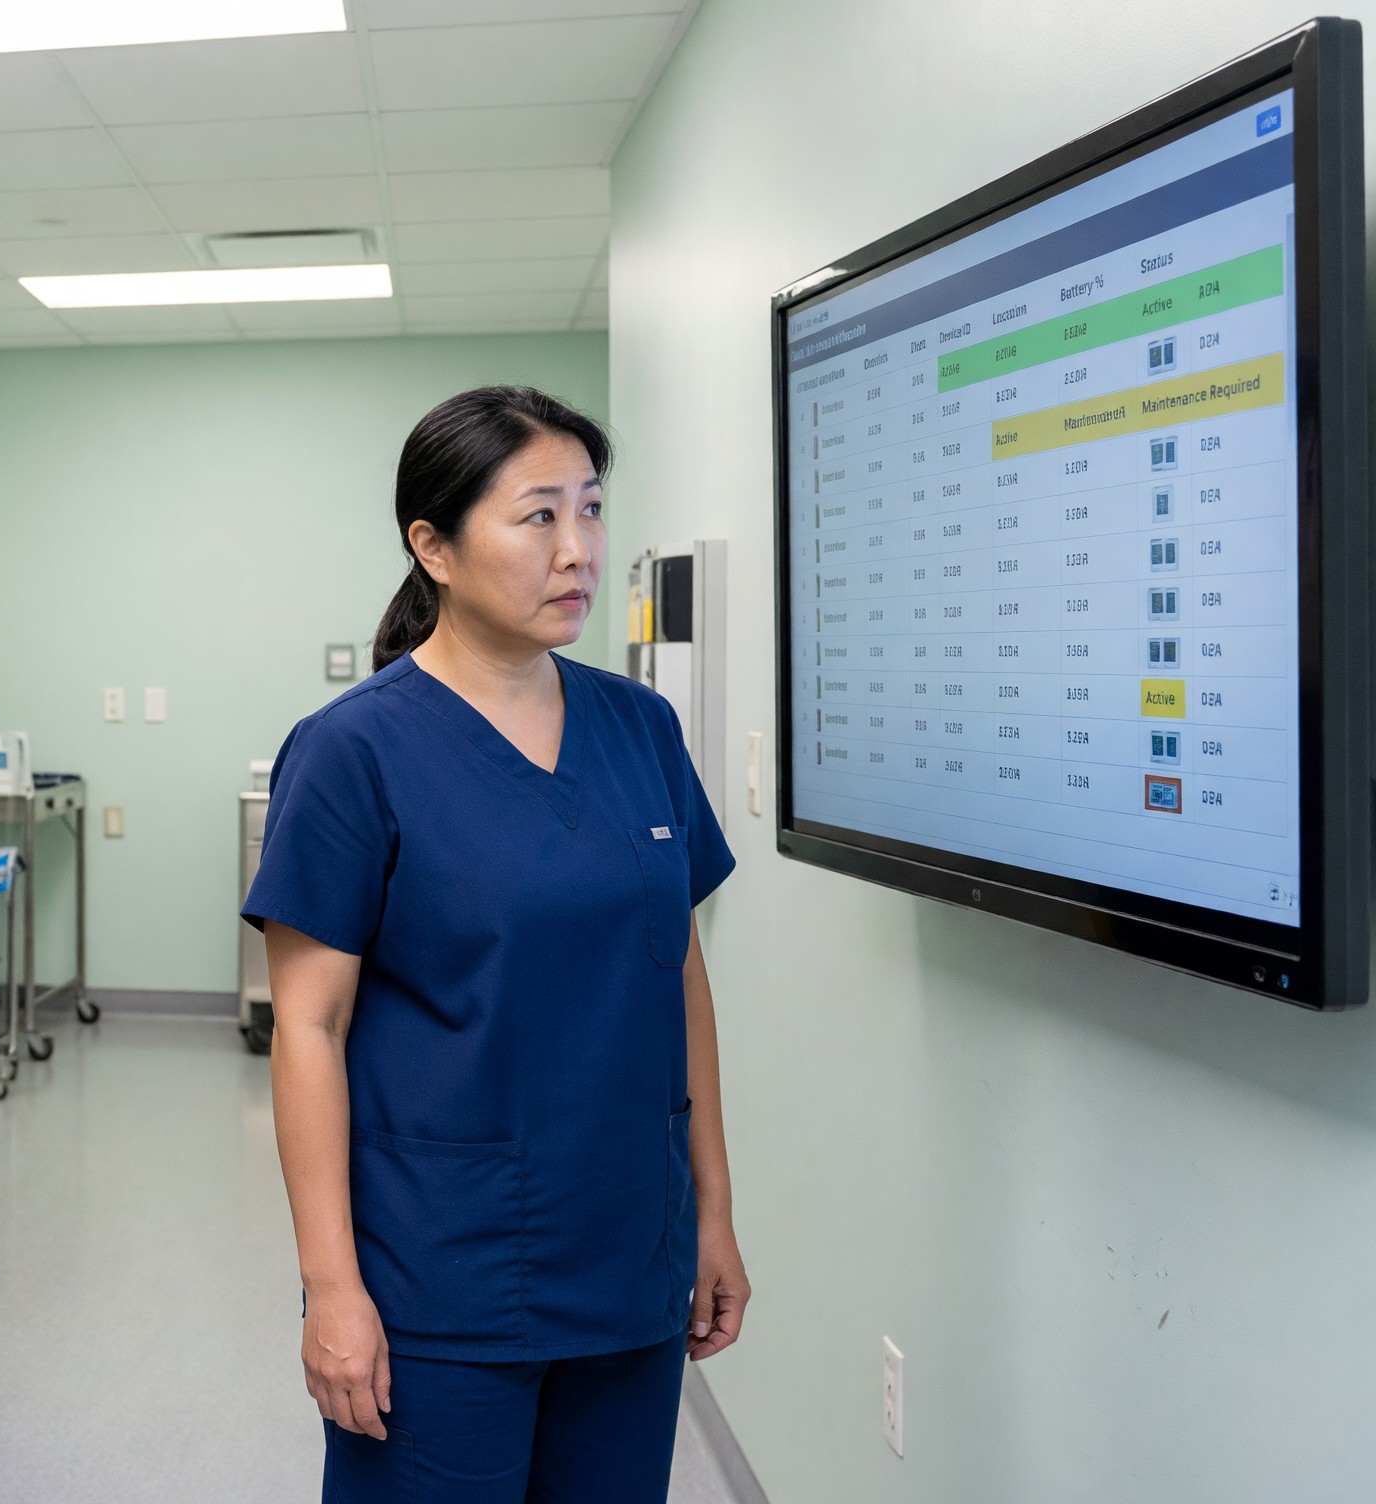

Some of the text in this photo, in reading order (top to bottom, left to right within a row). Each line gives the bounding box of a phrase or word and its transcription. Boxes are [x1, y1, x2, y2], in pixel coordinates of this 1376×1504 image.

[1140, 252, 1173, 274] Status
[1060, 274, 1104, 302] Battery %
[1143, 298, 1173, 317] Active
[1142, 374, 1260, 414] Maintenance Required
[1146, 691, 1176, 705] Active
